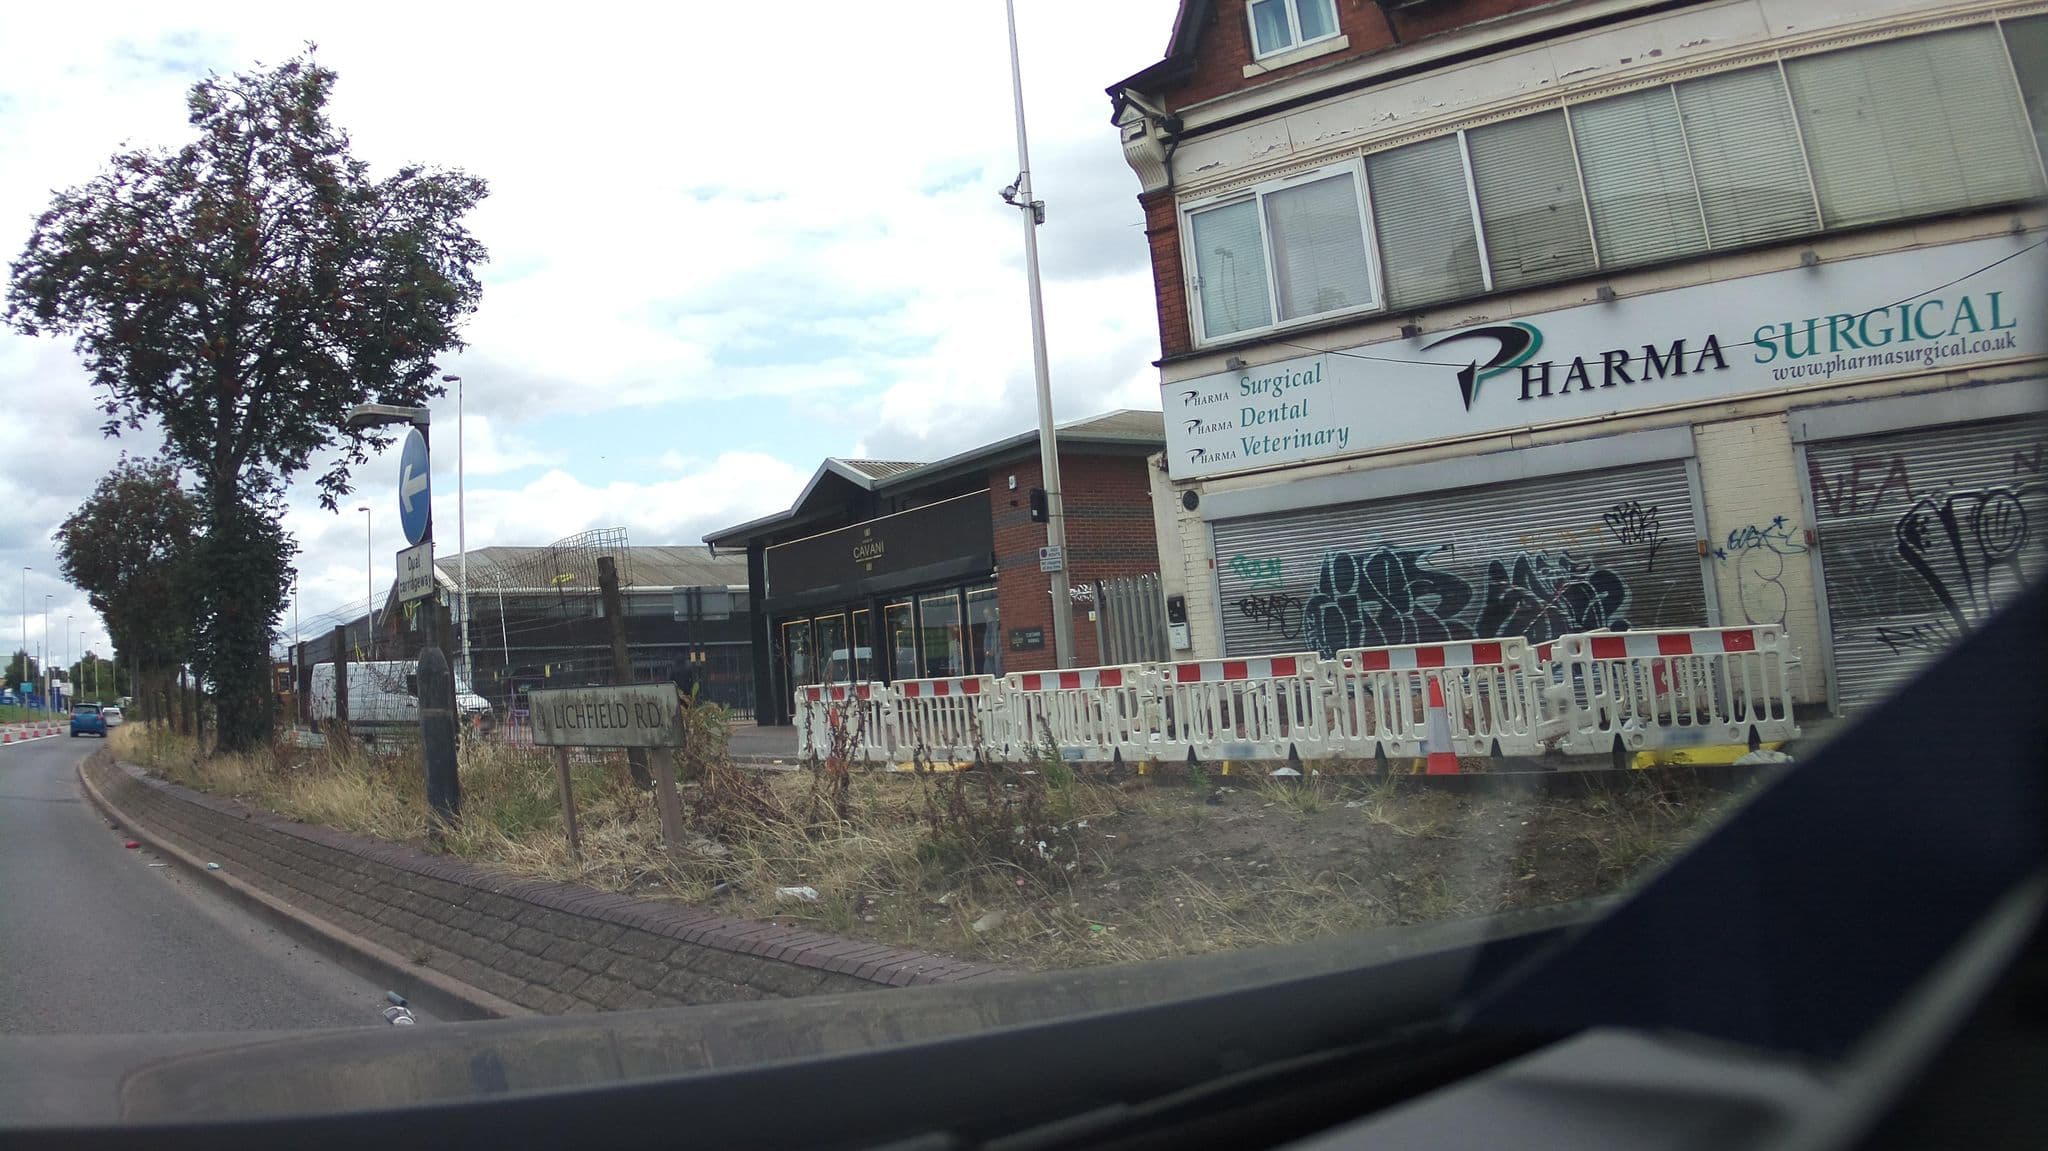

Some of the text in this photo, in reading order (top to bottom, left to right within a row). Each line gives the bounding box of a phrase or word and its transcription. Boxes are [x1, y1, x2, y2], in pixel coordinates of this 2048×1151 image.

[1753, 291, 2017, 364] SURGICAL
[1773, 331, 2017, 381] www.pharmasurgical.co.uk
[1239, 362, 1322, 399] Surgical
[1239, 399, 1308, 428] Dental
[1240, 425, 1349, 457] Veterinary
[408, 553, 420, 571] Dual
[853, 541, 884, 558] CAVANI
[554, 702, 664, 729] LICHFIELD RD.
